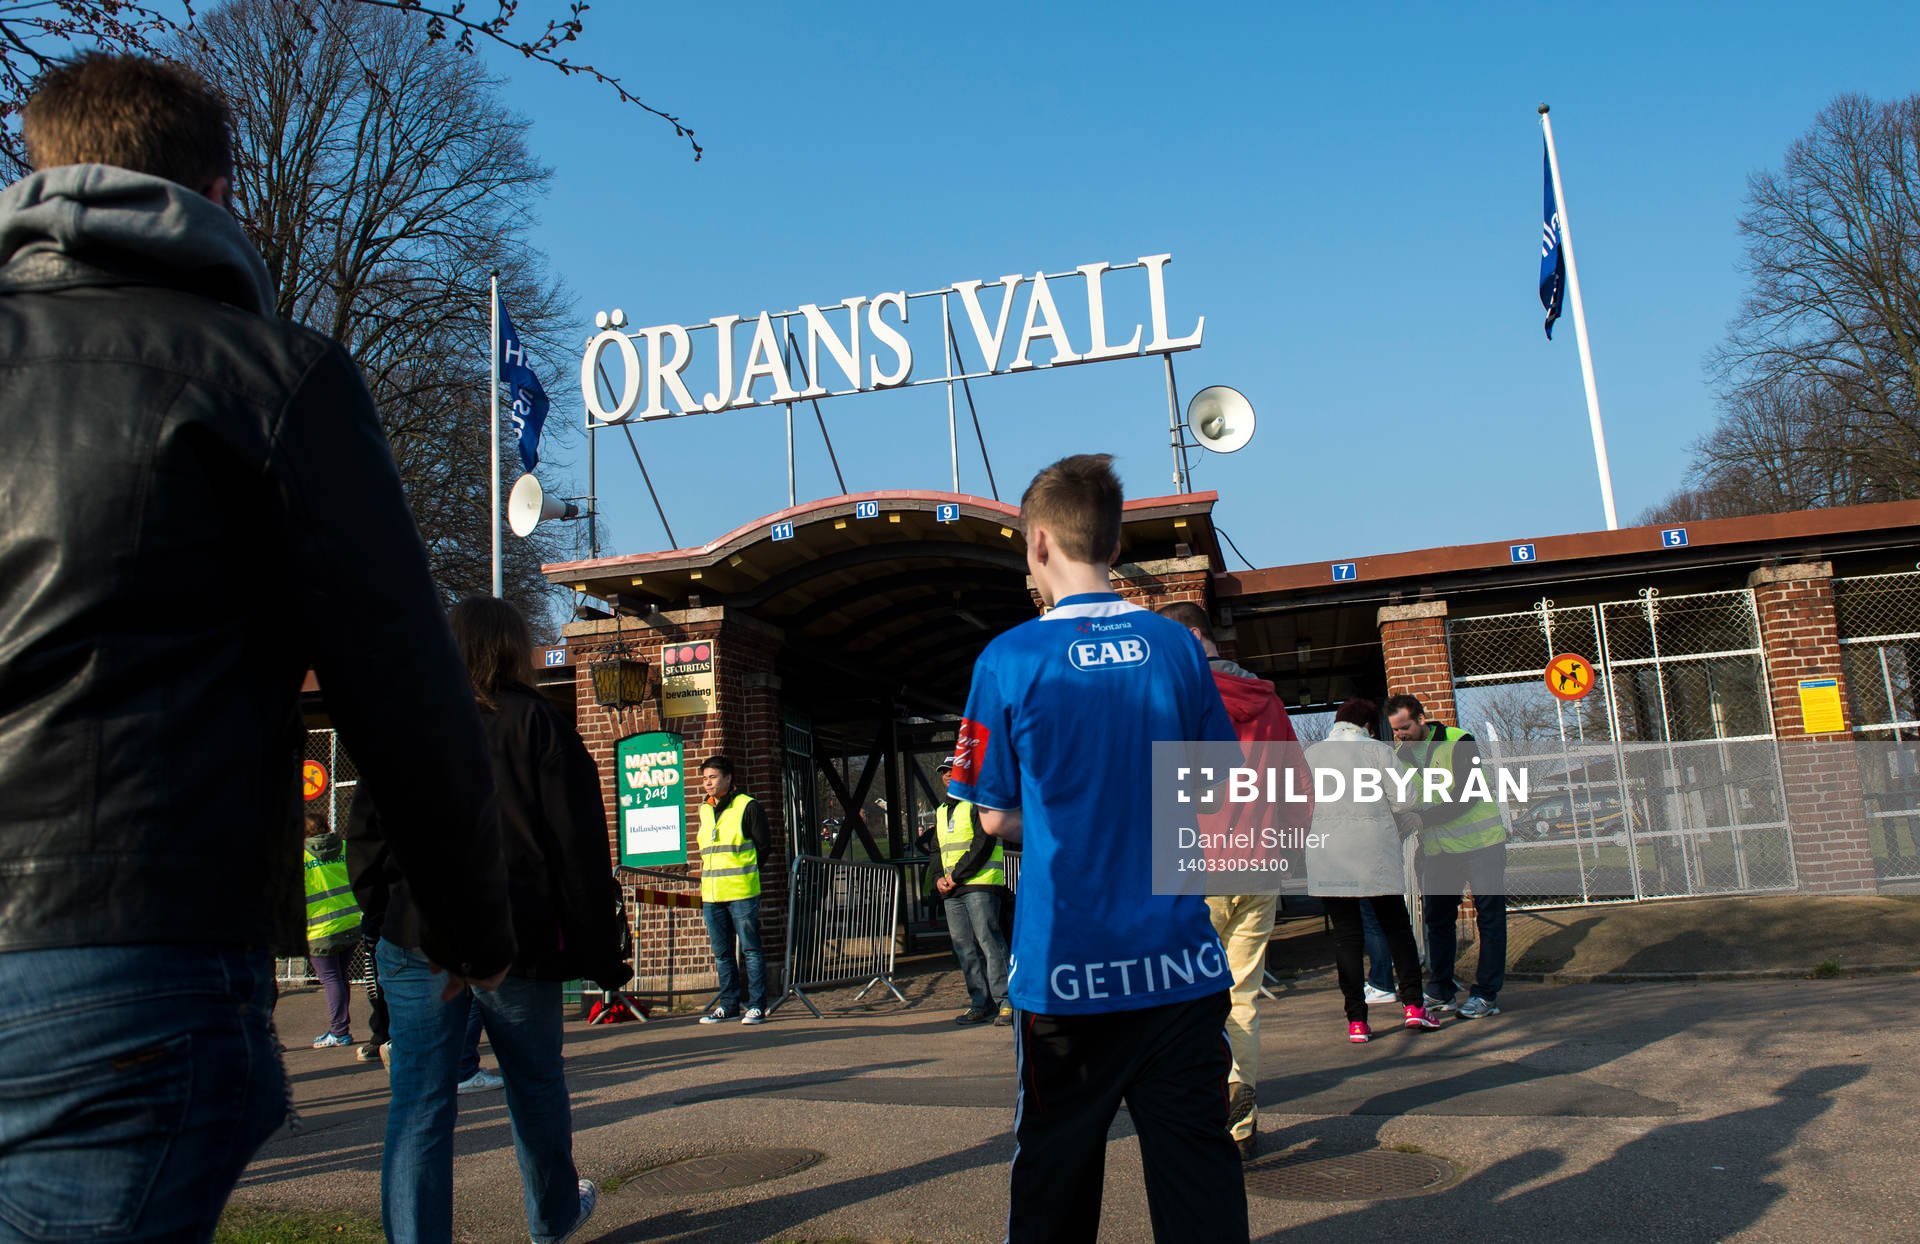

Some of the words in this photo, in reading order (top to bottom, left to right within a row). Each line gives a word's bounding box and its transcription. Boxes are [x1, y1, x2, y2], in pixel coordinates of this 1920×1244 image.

[581, 291, 912, 423] ÖRJANS
[952, 253, 1205, 372] VALL
[859, 503, 875, 516] 10
[943, 507, 952, 519] 9
[775, 525, 791, 538] 11
[1670, 531, 1680, 545] 5
[1518, 547, 1528, 560] 6
[1339, 566, 1348, 578] 7
[1091, 621, 1132, 631] Montania
[548, 651, 563, 664] 12
[1075, 640, 1143, 666] EAB
[665, 662, 710, 675] SECURITAS
[666, 687, 711, 699] bevakning
[625, 751, 678, 769] MATCH
[626, 766, 680, 788] VÄRD
[636, 793, 642, 805] i
[644, 786, 668, 800] dag
